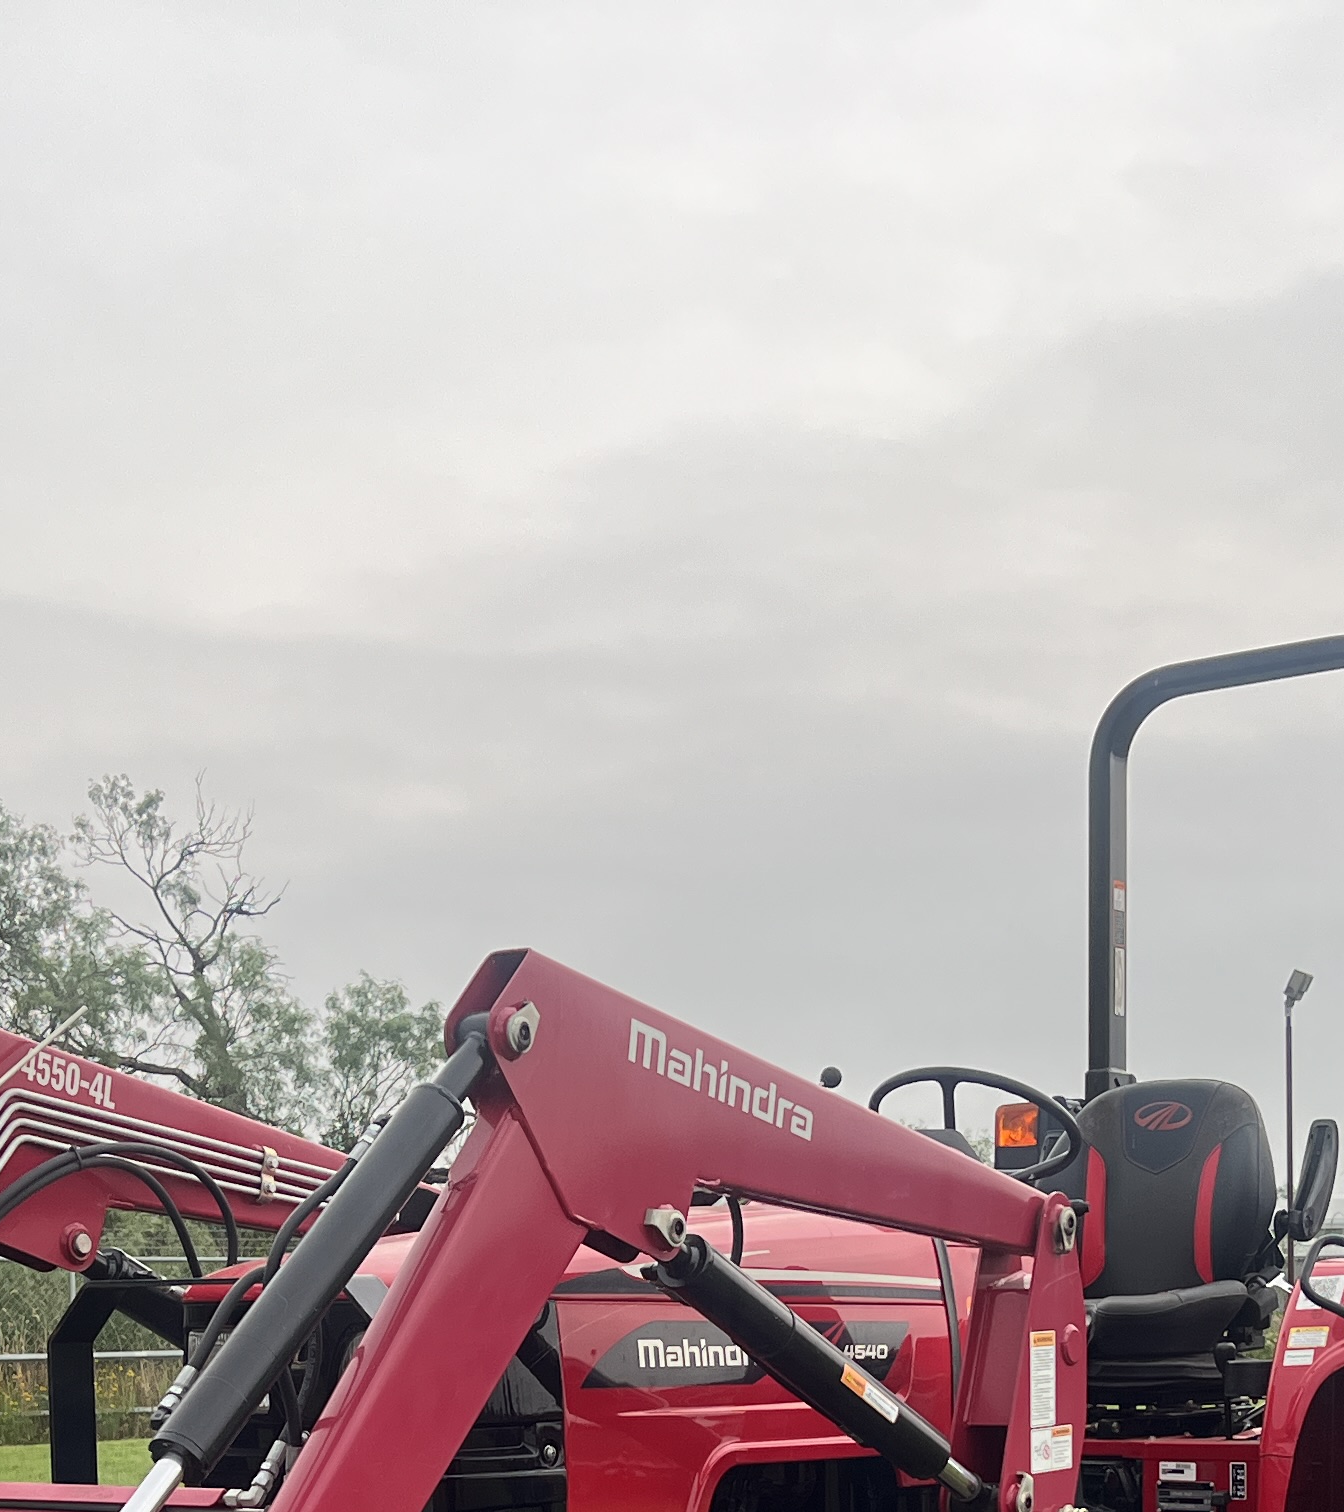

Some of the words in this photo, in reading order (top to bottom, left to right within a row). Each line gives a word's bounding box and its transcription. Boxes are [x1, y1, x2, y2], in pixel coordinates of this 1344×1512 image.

[20, 1047, 116, 1110] 4550-4L
[627, 1017, 814, 1142] Mahindra
[843, 1344, 889, 1360] 4540
